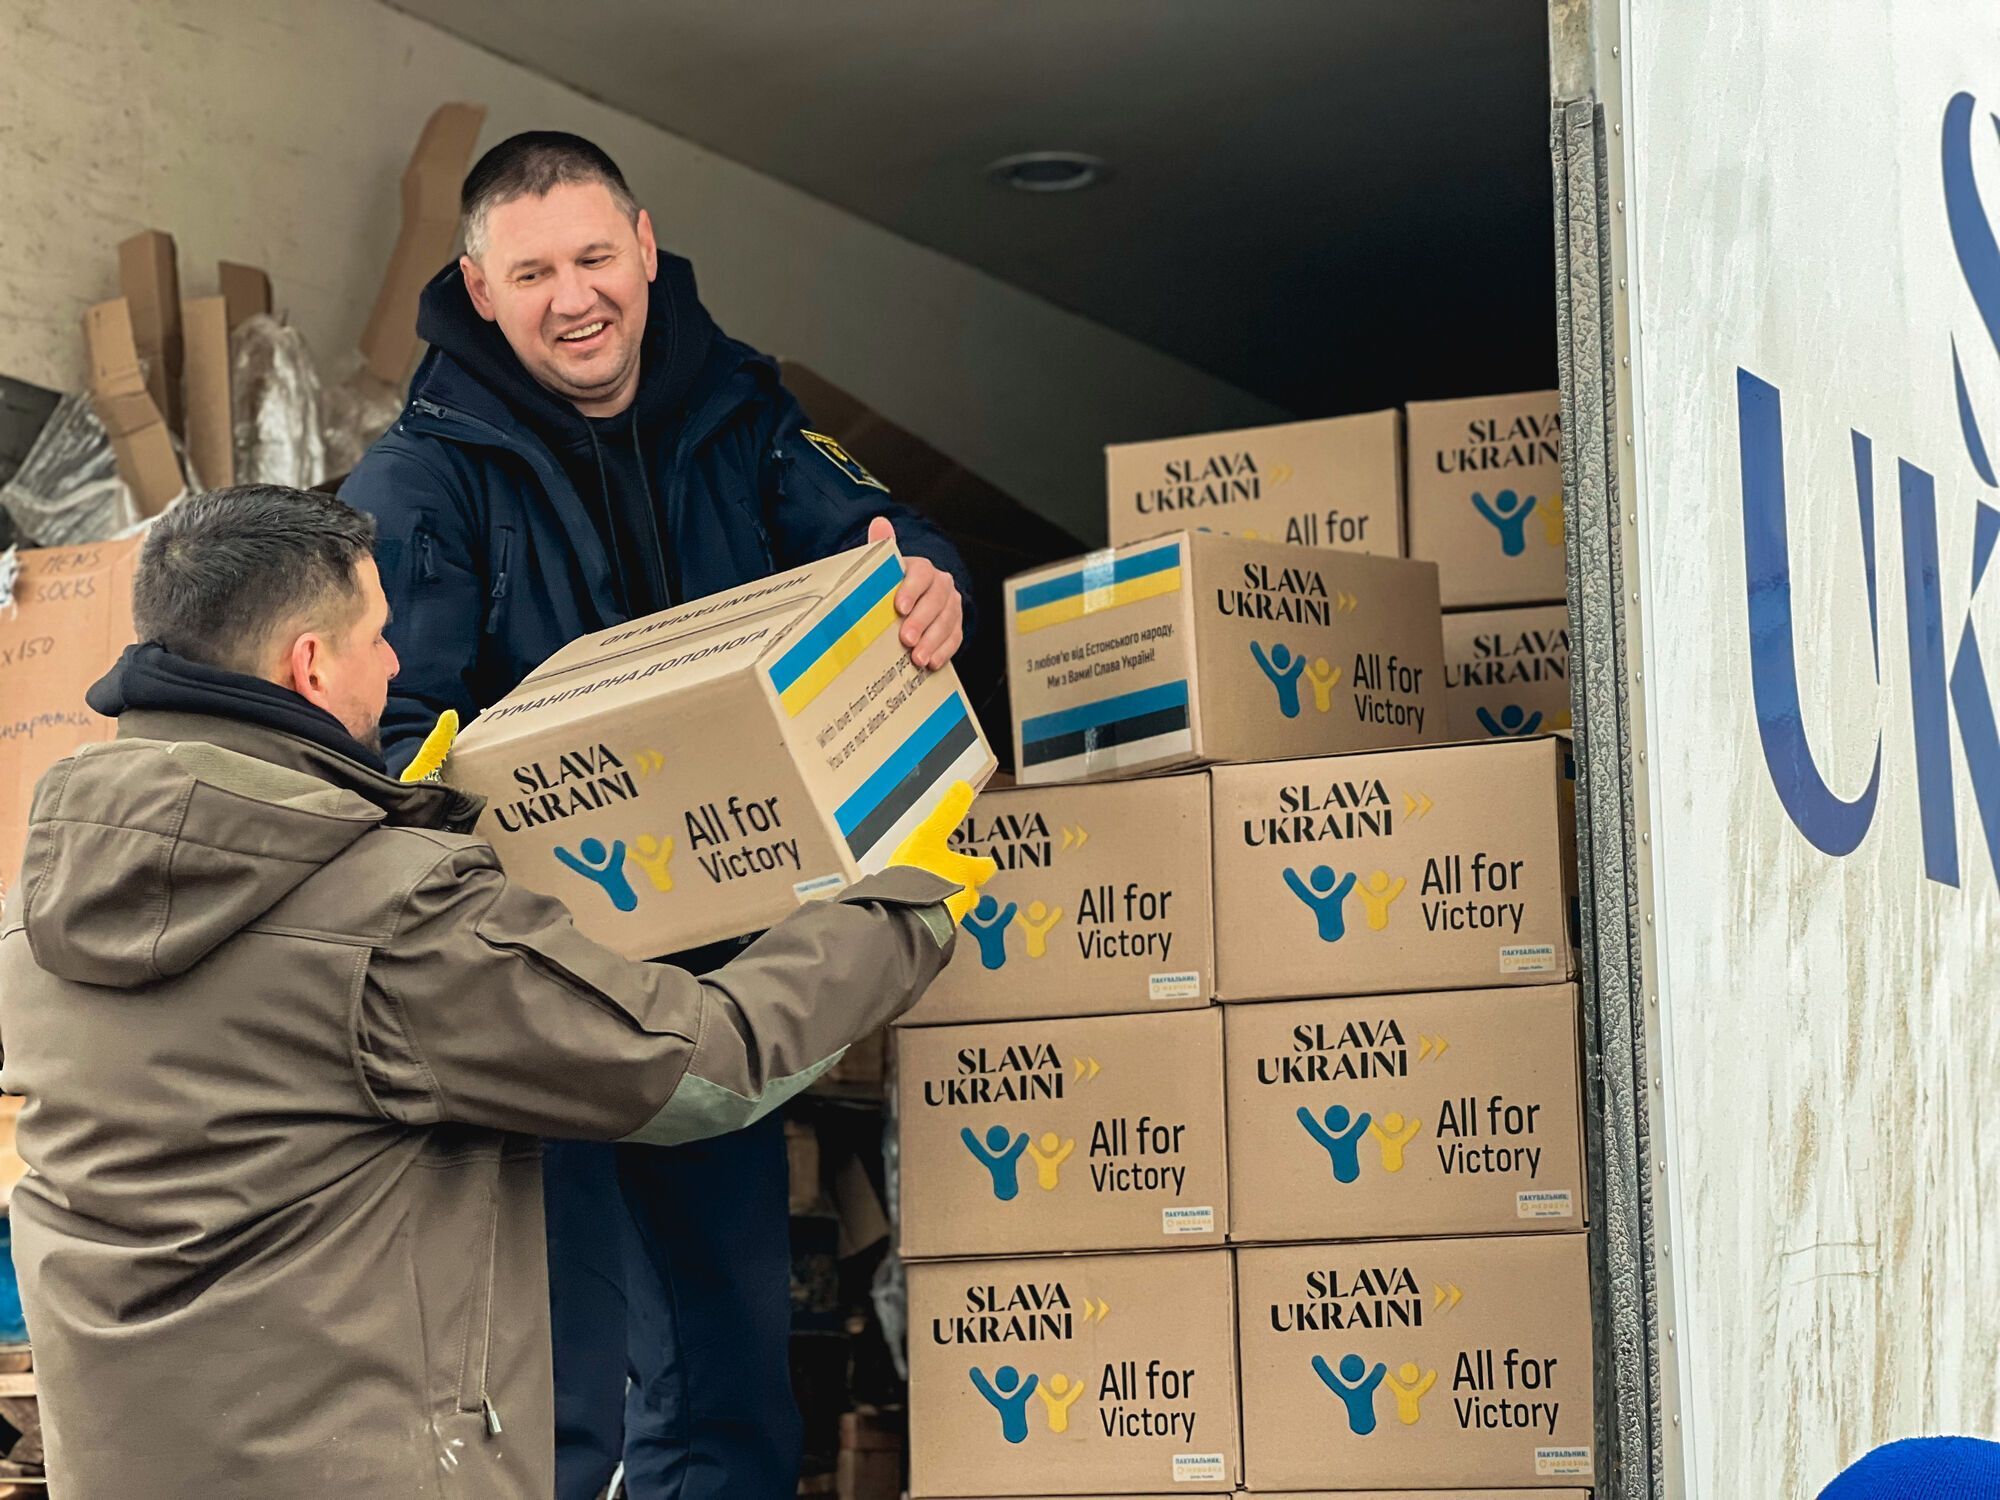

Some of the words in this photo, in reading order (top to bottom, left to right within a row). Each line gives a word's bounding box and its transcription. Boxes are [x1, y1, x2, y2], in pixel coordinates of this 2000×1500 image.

[1469, 413, 1561, 444] SLAVA
[1165, 451, 1258, 485] SLAVA
[1437, 440, 1559, 473] UKRAIN
[1136, 477, 1260, 514] UKRAINI
[1287, 513, 1318, 546] All
[1326, 510, 1369, 544] for
[40, 548, 101, 574] MENS
[38, 576, 95, 602] SOCKS
[1244, 563, 1328, 598] SLAVA
[638, 573, 812, 633] HUMANITARIAN
[1217, 589, 1331, 626] UKRAINI
[599, 628, 642, 647] AID
[1071, 647, 1085, 661] від
[1085, 633, 1139, 657] Естонського
[1141, 623, 1175, 642] народу.
[1474, 629, 1570, 659] SLAVA
[483, 669, 640, 723] ГУМАНІТАРНА
[637, 628, 769, 680] ДОПОМОГА
[1047, 676, 1060, 689] Ми
[1068, 664, 1093, 682] Вами!
[1094, 659, 1120, 676] Слава
[1121, 647, 1155, 670] Україні!
[1353, 653, 1381, 690] All
[1388, 656, 1423, 694] for
[816, 723, 838, 749] With
[834, 711, 852, 731] love
[849, 694, 869, 717] from
[866, 666, 898, 701] Estonian
[1354, 694, 1425, 734] Victory
[826, 752, 844, 771] You
[842, 741, 855, 759] are
[854, 728, 869, 747] not
[867, 710, 889, 735] alone.
[886, 690, 907, 714] Slava
[513, 743, 624, 795] SLAVA
[494, 771, 639, 833] UKRAINI
[1279, 779, 1391, 814] SLAVA
[684, 803, 730, 850] All
[727, 795, 782, 838] for
[947, 812, 1051, 846] SLAVA
[1244, 809, 1392, 847] UKRAINI
[698, 838, 801, 884] Victory
[950, 841, 1051, 871] AINI
[1421, 855, 1461, 896] All
[1471, 852, 1524, 892] for
[1077, 885, 1114, 925] All
[1123, 883, 1173, 921] for
[1422, 902, 1525, 934] Victory
[1078, 930, 1173, 962] Victory
[1293, 1019, 1406, 1052] SLAVA
[958, 1043, 1062, 1075] SLAVA
[1257, 1049, 1408, 1085] UKRAINI
[924, 1073, 1064, 1106] UKRAINI
[1436, 1097, 1477, 1138] All
[1487, 1095, 1540, 1136] for
[1089, 1118, 1127, 1158] All
[1136, 1116, 1186, 1155] for
[1090, 1162, 1186, 1196] Victory
[1437, 1143, 1542, 1179] Victory
[966, 1283, 1071, 1314] SLAVA
[1306, 1267, 1420, 1299] SLAVA
[933, 1313, 1073, 1345] UKRAINI
[1271, 1299, 1422, 1332] UKRAINI
[1099, 1361, 1136, 1401] All
[1145, 1360, 1195, 1400] for
[1453, 1349, 1493, 1391] All
[1504, 1348, 1558, 1390] for
[1099, 1406, 1196, 1443] Victory
[1454, 1397, 1559, 1435] Victory
